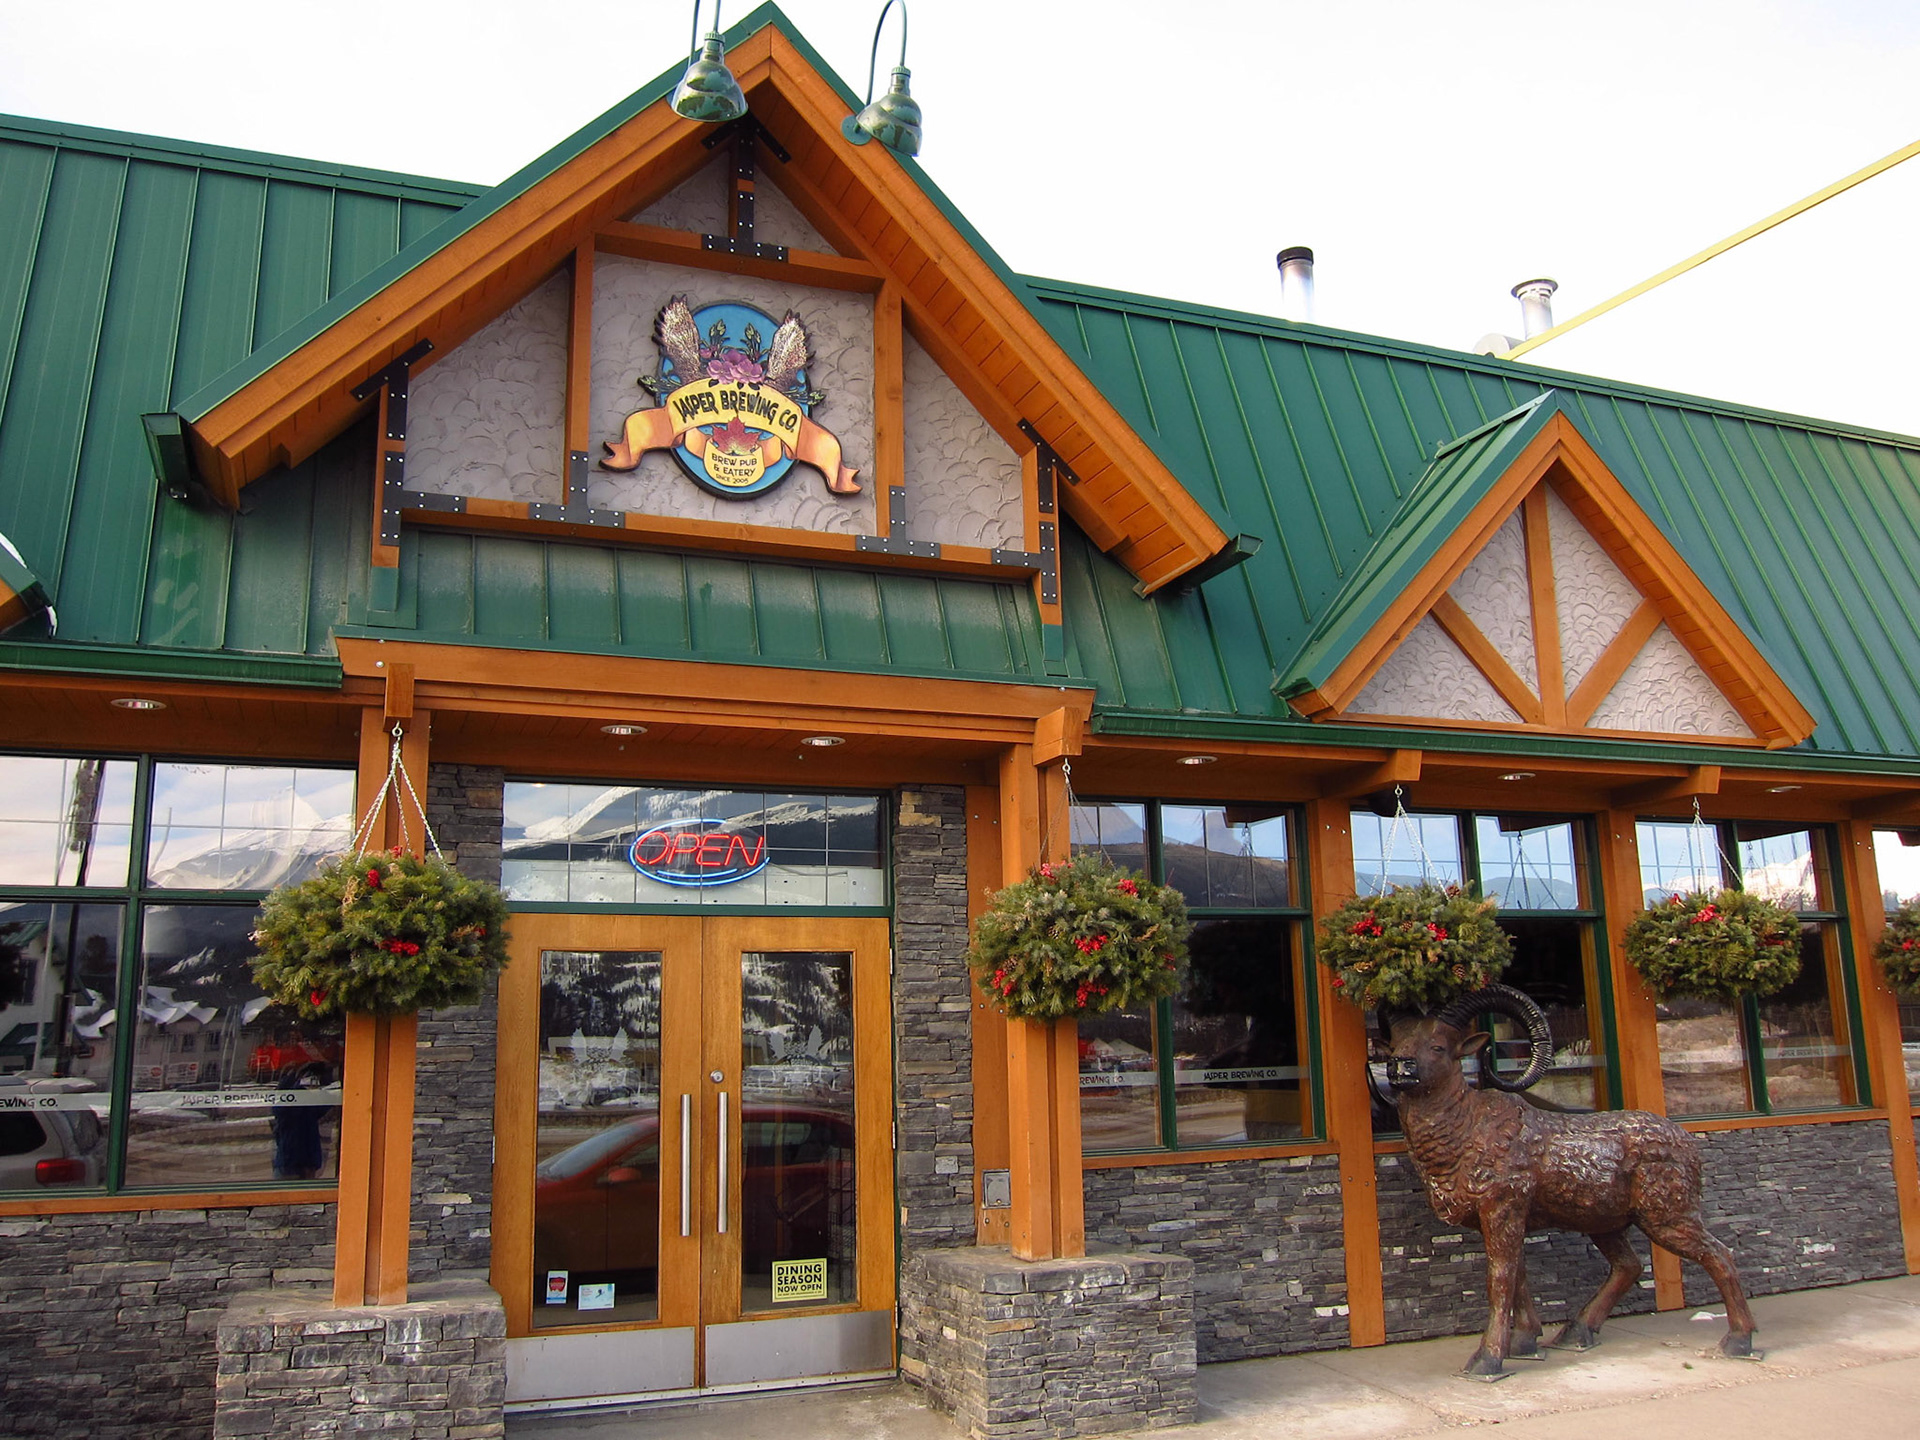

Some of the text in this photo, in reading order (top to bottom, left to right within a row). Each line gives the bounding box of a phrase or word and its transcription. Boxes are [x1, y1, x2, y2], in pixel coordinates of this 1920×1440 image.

[672, 391, 719, 423] JASPER
[720, 390, 779, 425] BREWING
[711, 452, 757, 466] BREW PUB
[713, 463, 756, 477] & EATERY
[716, 474, 731, 482] SINCE
[635, 831, 764, 866] OPEN
[1231, 1069, 1265, 1080] BREWING
[40, 1098, 58, 1107] CO.
[181, 1093, 298, 1106] JASPER BREWING CO.
[777, 1264, 822, 1276] DINING
[777, 1274, 822, 1286] SEASON
